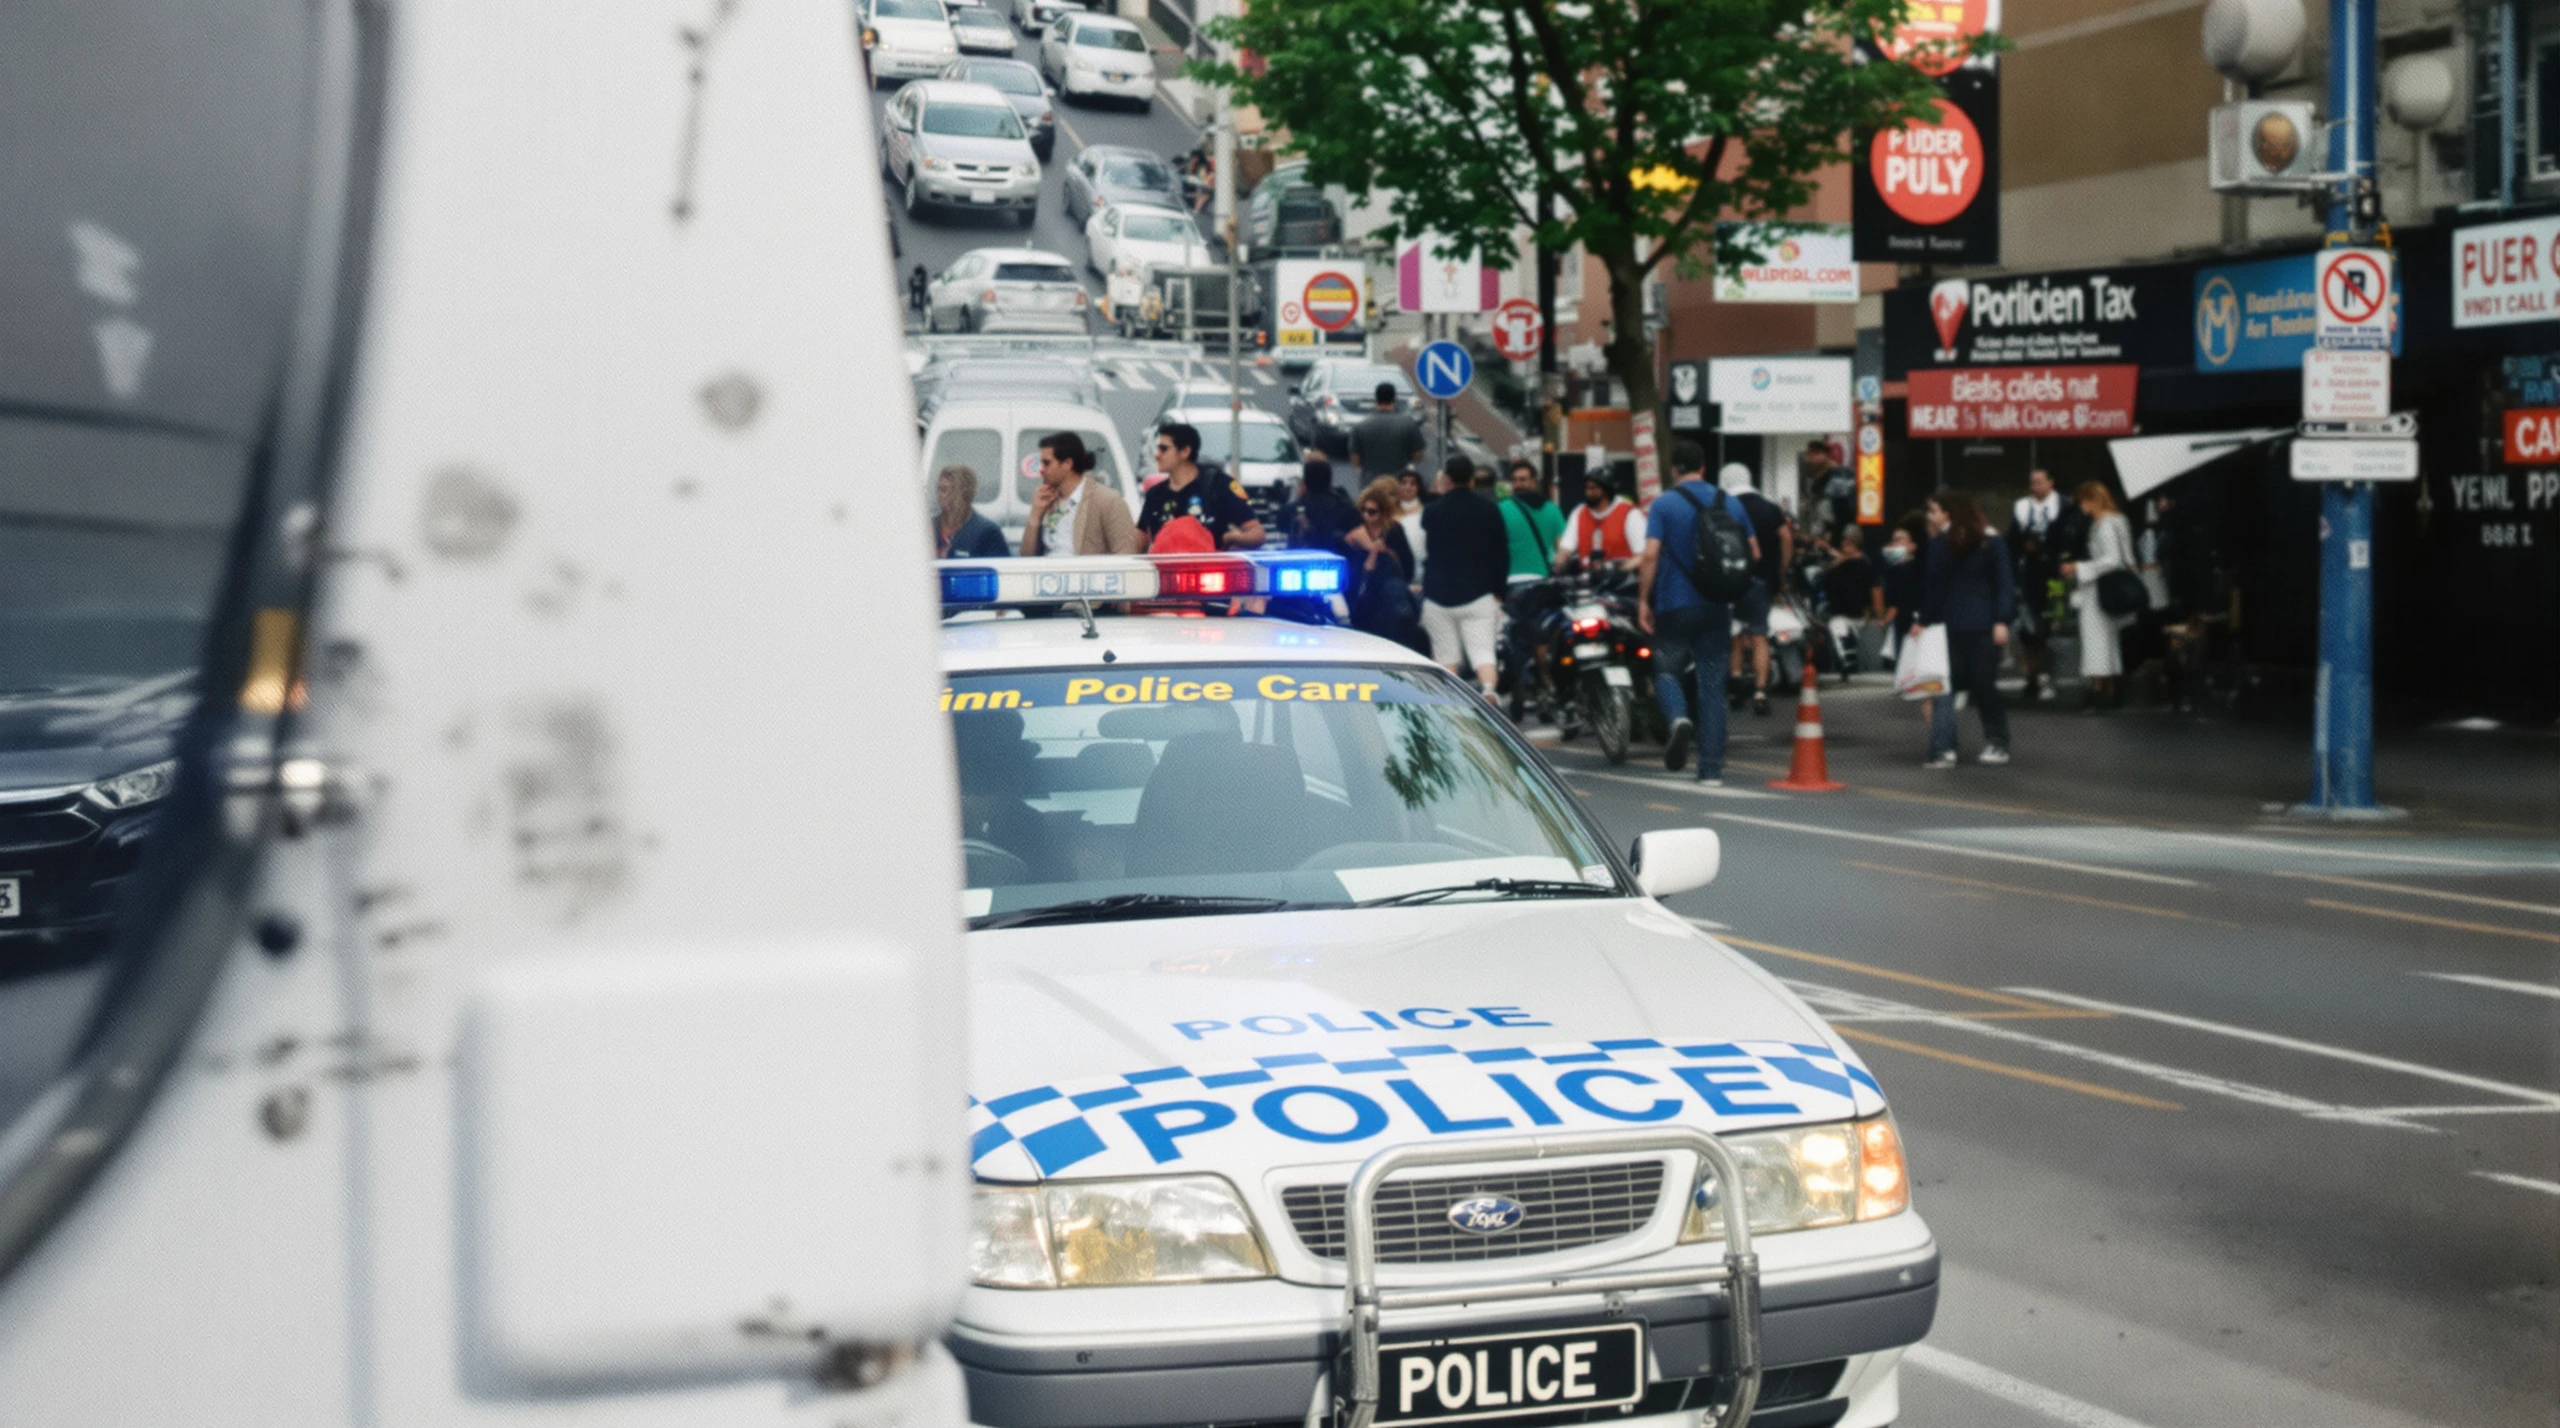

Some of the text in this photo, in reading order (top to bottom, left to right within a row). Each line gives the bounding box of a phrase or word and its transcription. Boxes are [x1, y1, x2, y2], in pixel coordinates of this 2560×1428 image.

[1886, 156, 1969, 195] PULY
[2089, 275, 2137, 321] Tax
[1427, 350, 1461, 389] N
[1065, 677, 1233, 704] Police
[1257, 674, 1379, 702] Carr
[1171, 1006, 1553, 1041] POLICE
[1118, 1065, 1804, 1164] POLICE
[1400, 1341, 1598, 1413] POLICE
